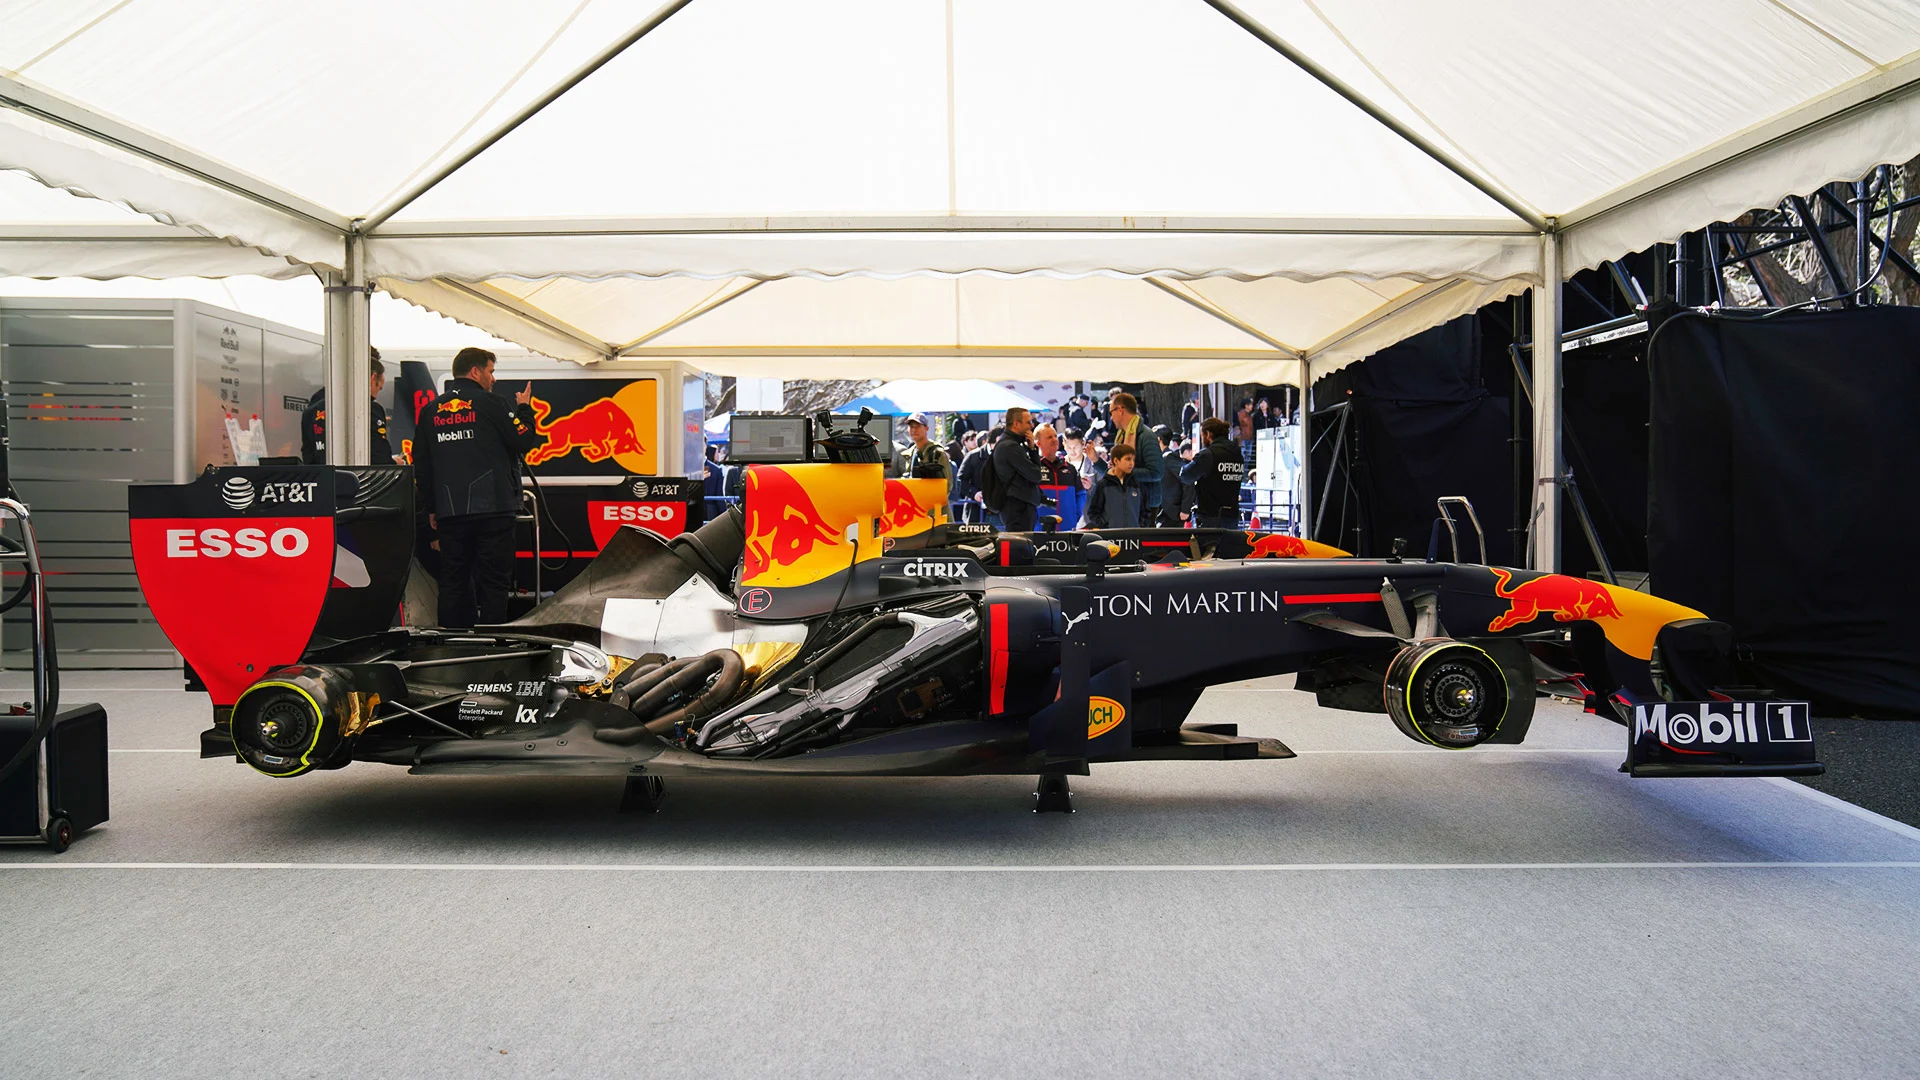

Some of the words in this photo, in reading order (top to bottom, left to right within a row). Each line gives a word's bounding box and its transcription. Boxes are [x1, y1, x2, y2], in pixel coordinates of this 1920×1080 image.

[283, 395, 309, 412] PIRELL
[455, 411, 476, 424] Bull
[437, 430, 463, 442] Mobil
[1217, 462, 1244, 473] OFFICIA
[261, 482, 318, 503] AT&T
[651, 484, 680, 496] AT&T
[603, 505, 674, 521] ESSO
[166, 527, 309, 558] ESSO
[1090, 593, 1152, 617] TON
[1166, 590, 1279, 615] MARTIN
[466, 683, 513, 693] SIEMENS
[515, 681, 545, 697] IBM
[458, 714, 485, 722] Enterprise
[459, 707, 481, 715] Hewlett
[481, 708, 503, 716] Packard
[1634, 702, 1759, 745] Mobil
